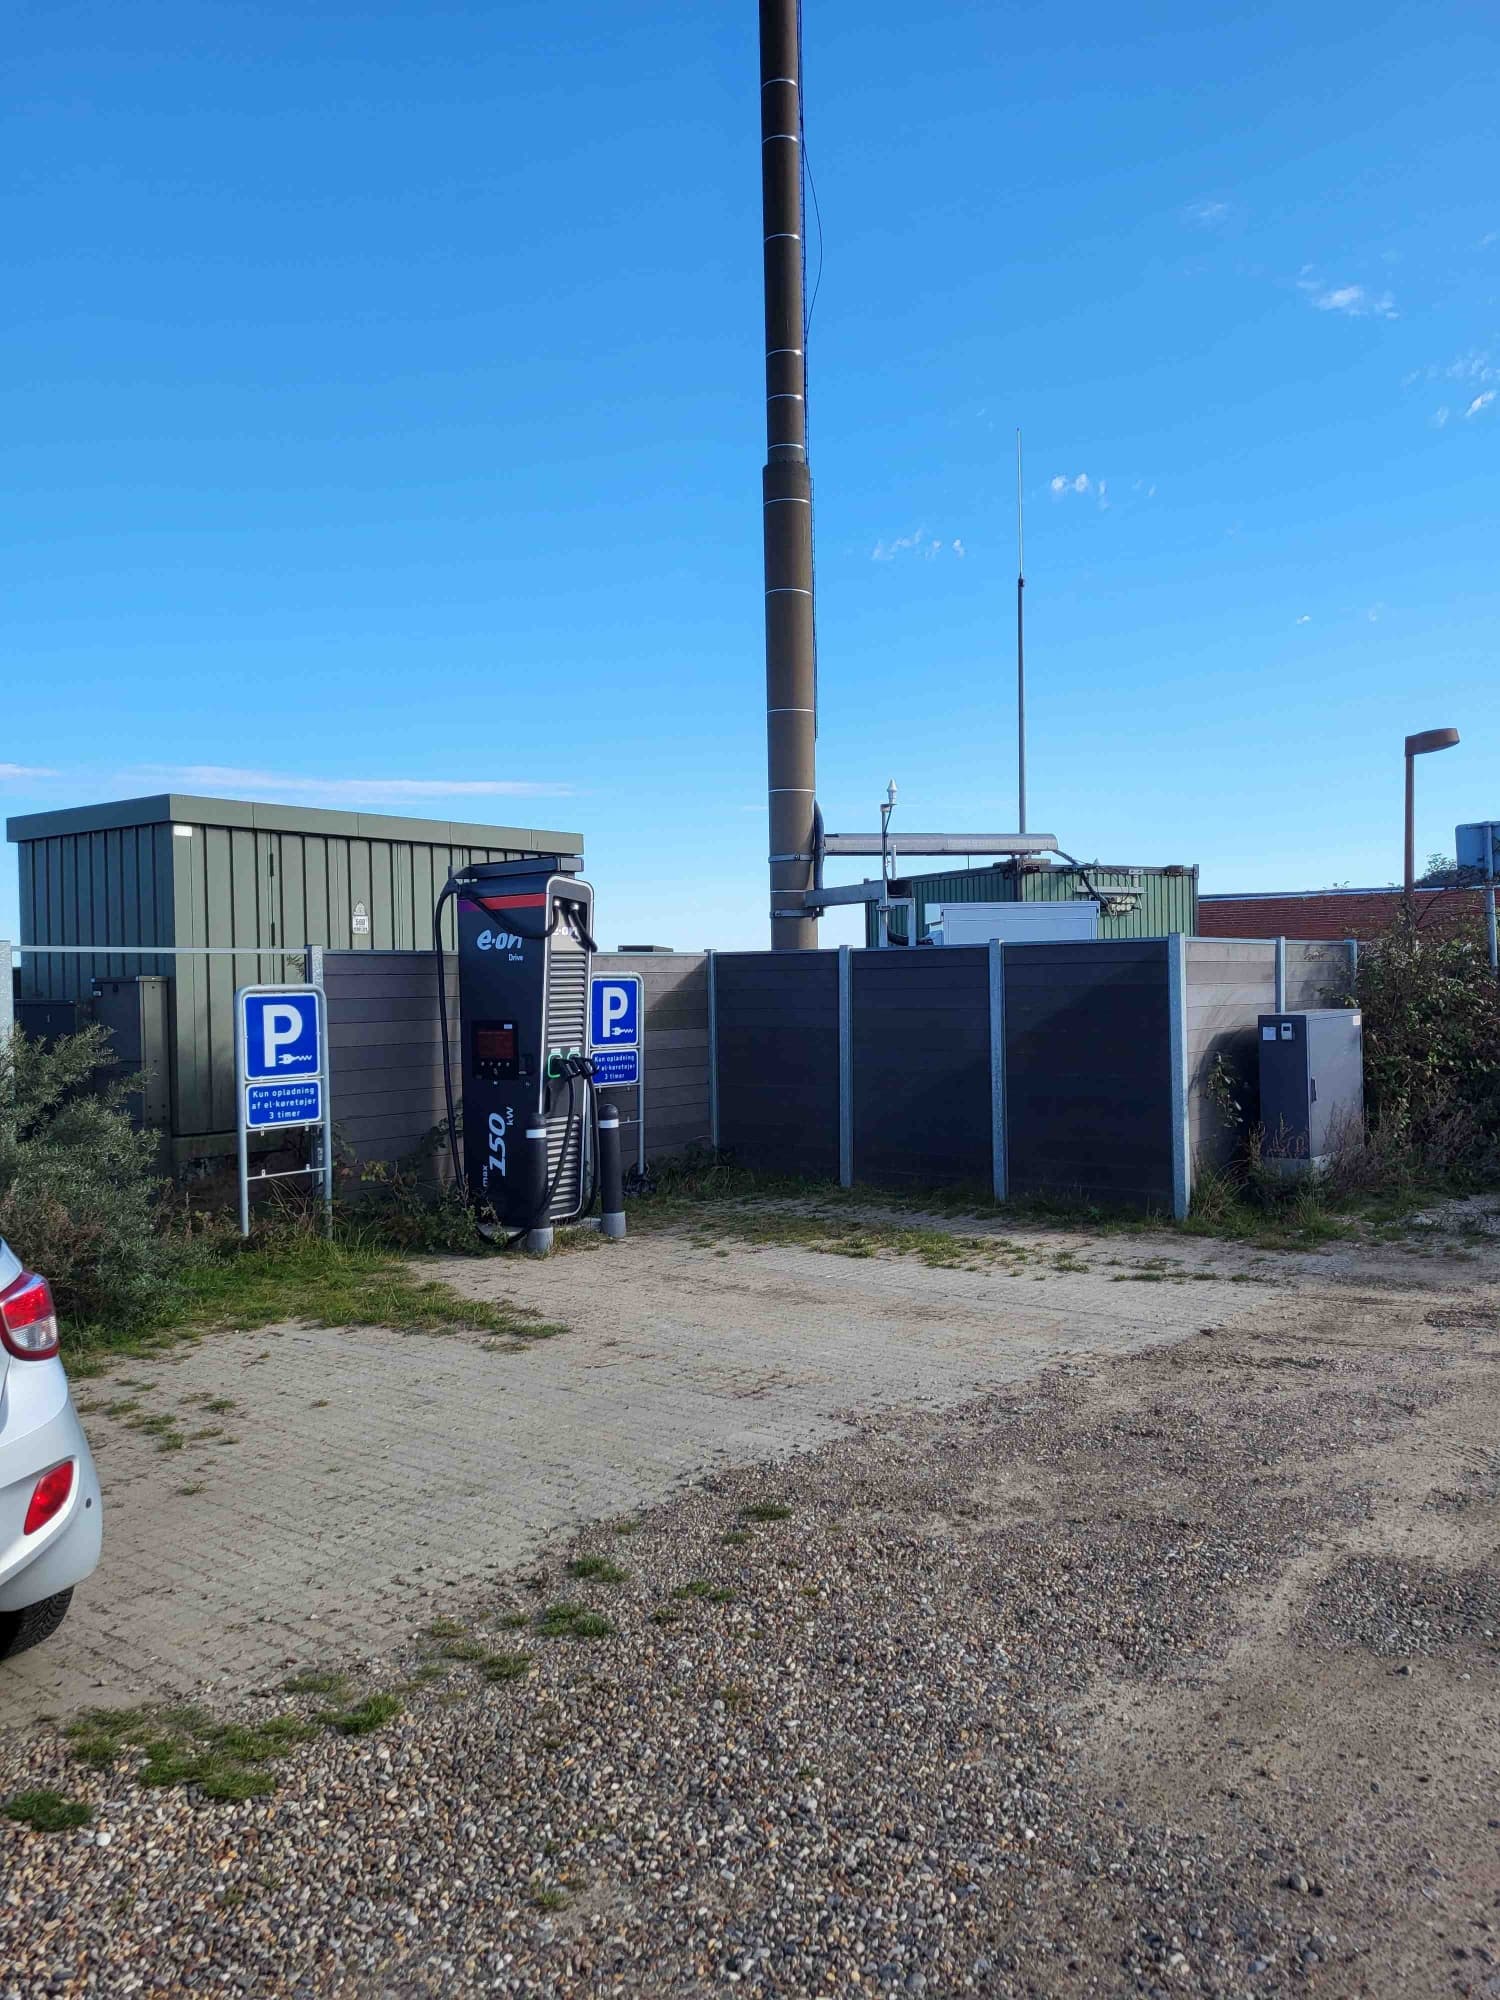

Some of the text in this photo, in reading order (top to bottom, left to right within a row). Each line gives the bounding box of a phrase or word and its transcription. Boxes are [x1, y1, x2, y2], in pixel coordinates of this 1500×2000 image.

[508, 953, 524, 961] Drive
[602, 987, 629, 1037] P
[262, 1004, 303, 1068] P
[252, 1087, 315, 1098] Kun opladning
[251, 1101, 260, 1110] af
[269, 1110, 301, 1119] 3 timer
[488, 1112, 506, 1177] 150
[506, 1106, 514, 1126] kW
